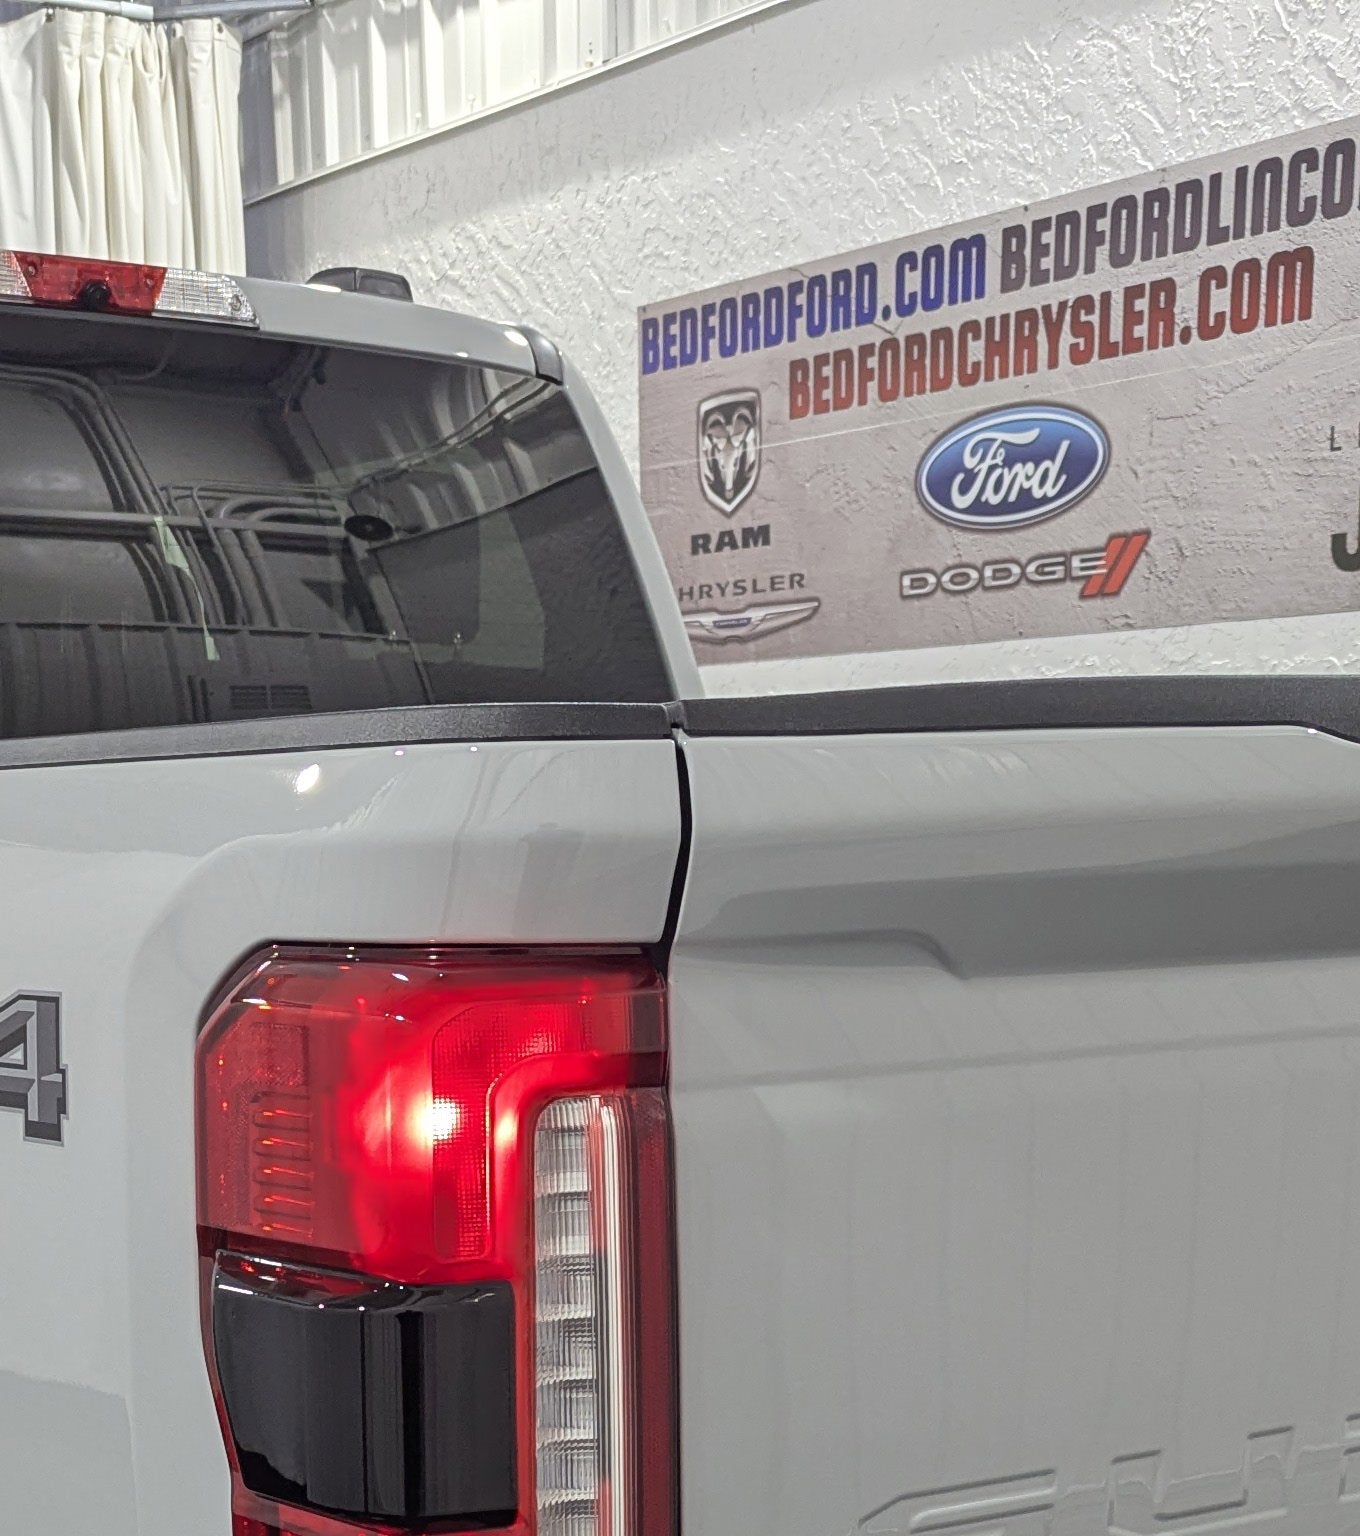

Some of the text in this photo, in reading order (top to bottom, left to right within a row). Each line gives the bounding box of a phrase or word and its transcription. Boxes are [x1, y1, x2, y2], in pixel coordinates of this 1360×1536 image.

[642, 233, 986, 375] BEDFORDFORD.COM
[789, 246, 1314, 420] BEDFORDCHRYSLER.COM
[951, 427, 1070, 509] Ford
[691, 524, 771, 556] RAM
[678, 573, 806, 601] HRYSLER
[900, 550, 1107, 598] DODGE
